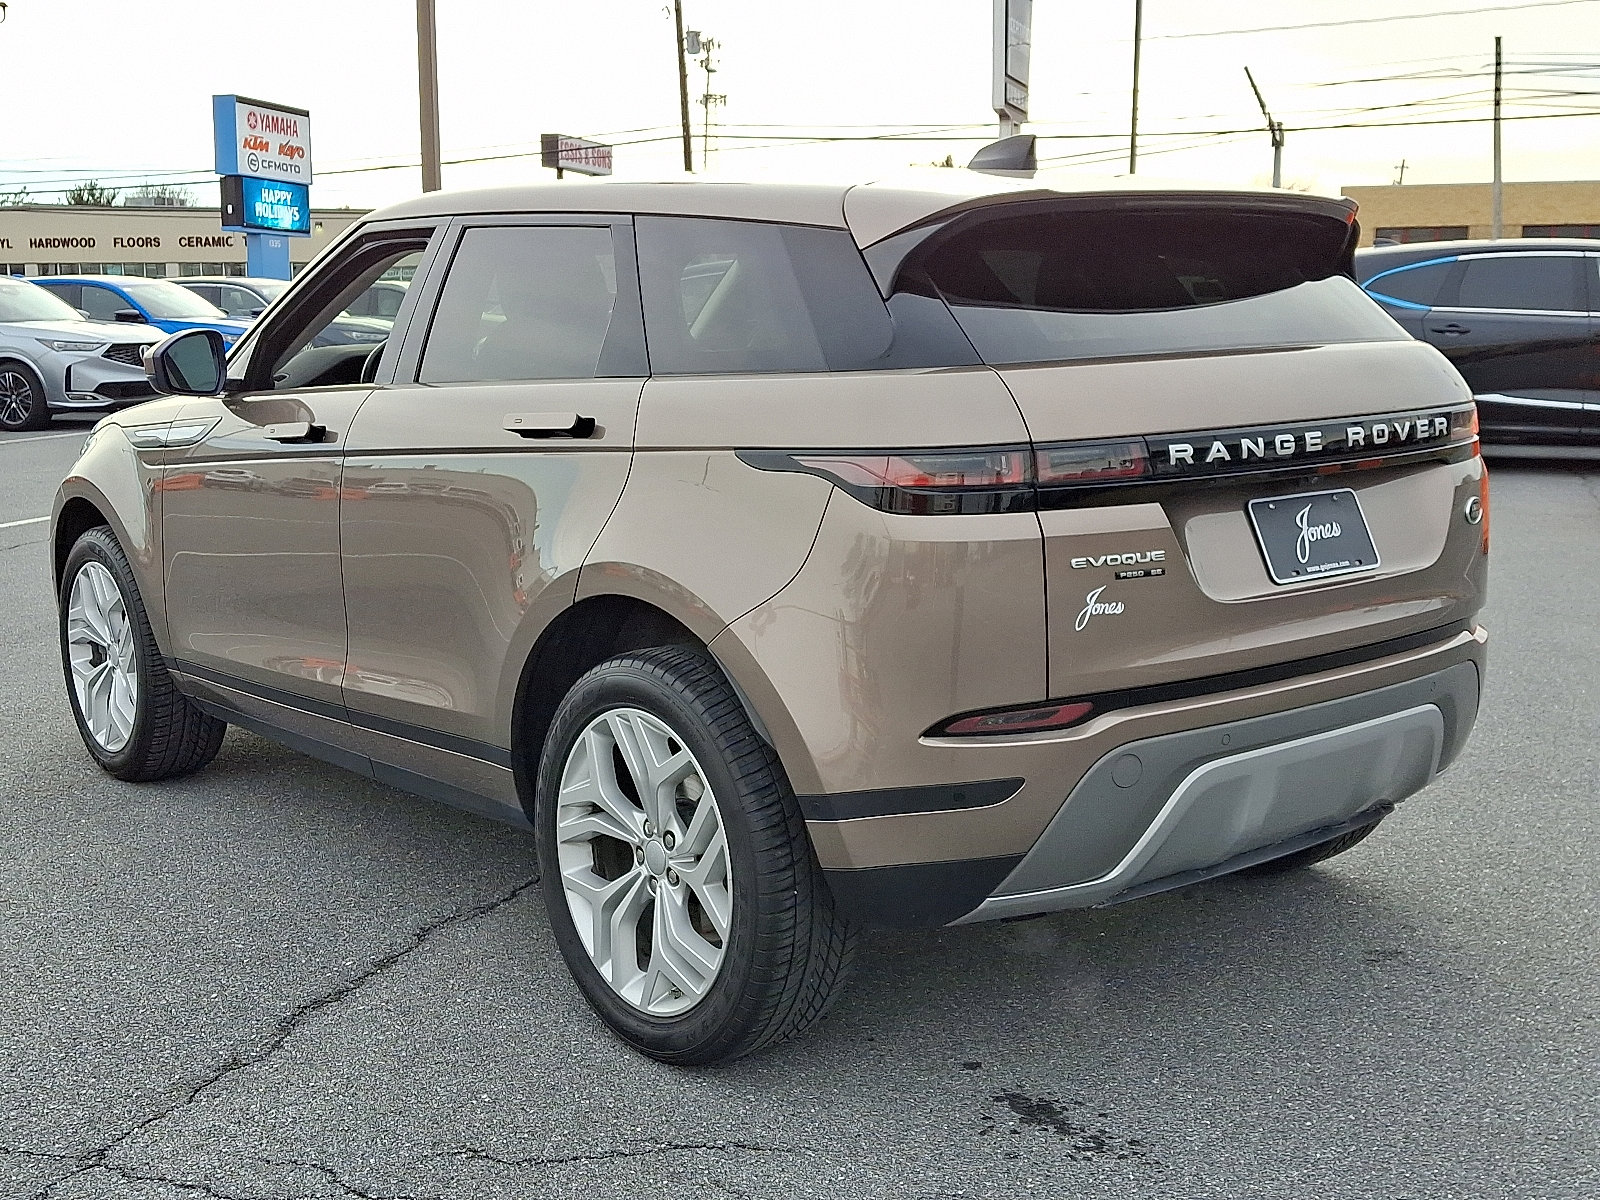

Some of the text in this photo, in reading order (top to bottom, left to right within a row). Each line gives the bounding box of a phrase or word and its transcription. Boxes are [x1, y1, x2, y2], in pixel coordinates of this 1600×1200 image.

[259, 112, 299, 138] YAMAHA
[242, 134, 269, 153] KTM
[261, 159, 301, 174] CFMOTO
[261, 187, 293, 205] HAPPY
[254, 201, 300, 222] HOLIDAYS
[29, 237, 96, 249] HARDWOOD
[113, 237, 161, 248] FLOORS
[178, 235, 234, 248] CERAMIC
[1169, 416, 1449, 465] RANGE ROVER
[1295, 503, 1342, 564] Jones
[1070, 550, 1166, 569] EVOQUE
[1075, 584, 1125, 631] Jones
